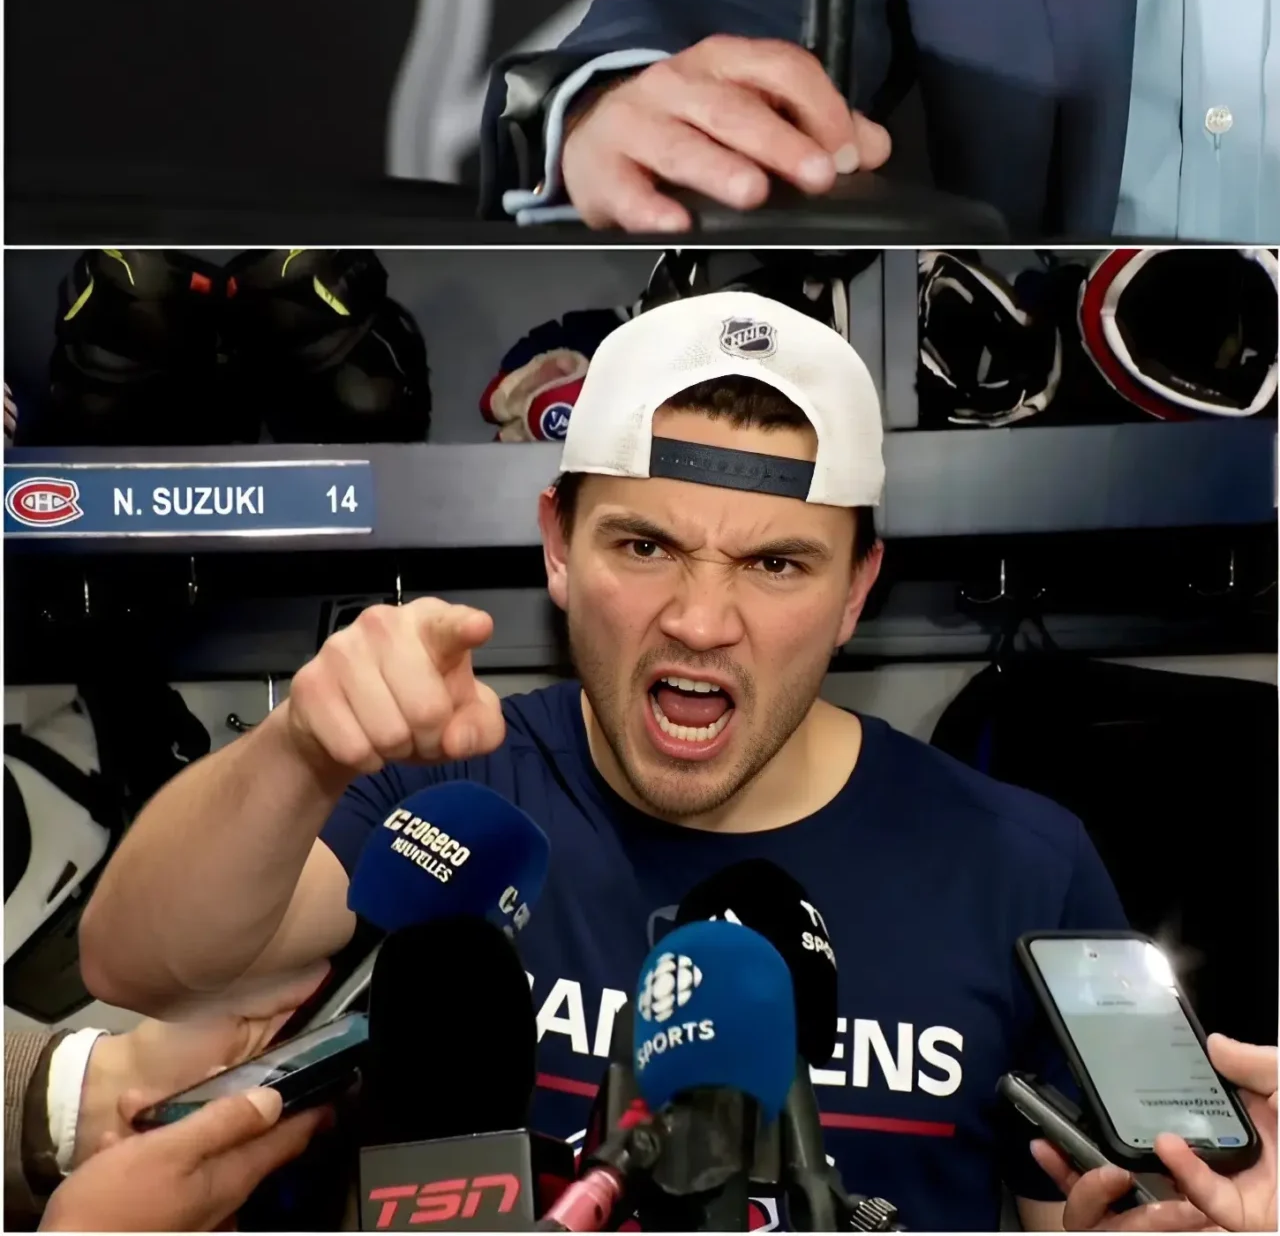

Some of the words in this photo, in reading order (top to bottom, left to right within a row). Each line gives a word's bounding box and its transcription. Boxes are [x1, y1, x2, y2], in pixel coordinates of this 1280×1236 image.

[113, 487, 142, 515] N.
[152, 485, 265, 515] SUZUKI
[325, 484, 359, 514] 14
[636, 1019, 716, 1070] SPORTS
[367, 1173, 522, 1229] TSN
